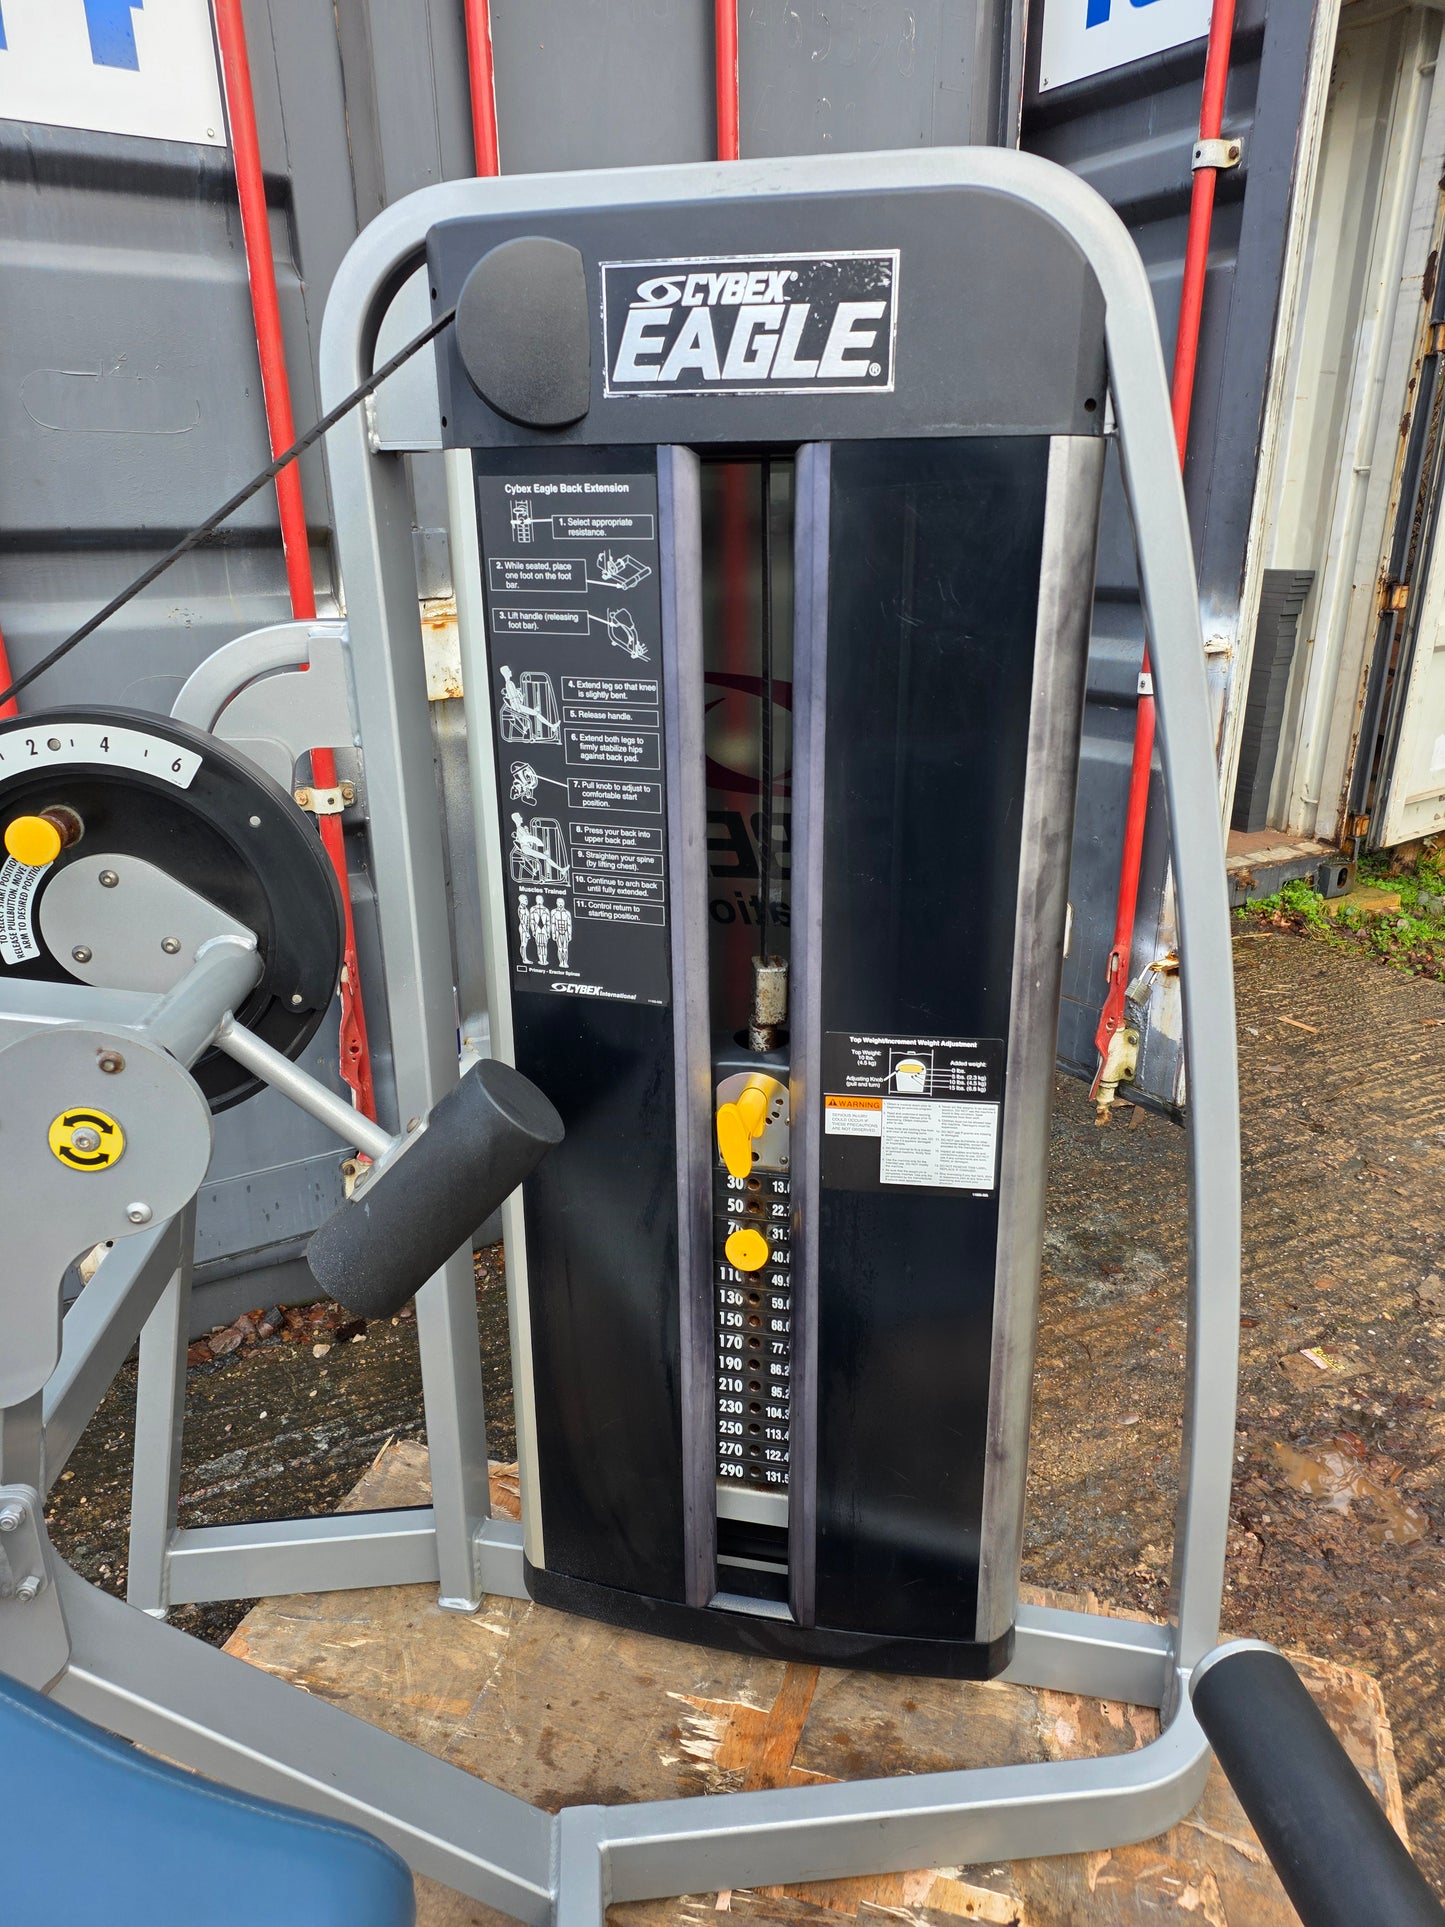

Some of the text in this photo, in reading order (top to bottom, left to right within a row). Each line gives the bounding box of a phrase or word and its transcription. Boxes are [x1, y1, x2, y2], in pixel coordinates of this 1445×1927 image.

[505, 482, 629, 495] Cybex Eagle Back Extension
[567, 517, 590, 526] Select
[591, 517, 633, 528] appropriate
[568, 528, 606, 536] resistance.
[504, 561, 524, 571] While
[525, 562, 551, 570] seated,
[552, 562, 572, 572] place
[519, 571, 533, 579] foot
[557, 571, 572, 580] foot
[506, 580, 520, 590] bar.
[507, 611, 518, 621] Lift
[519, 612, 543, 622] handle
[544, 612, 579, 622] (releasing
[508, 620, 539, 630] foot bar).
[576, 680, 601, 689] Extend
[623, 682, 638, 690] that
[638, 683, 656, 691] knee
[585, 690, 609, 700] slightly
[610, 690, 628, 699] bent.
[578, 710, 606, 719] Release
[607, 711, 632, 720] handle.
[579, 733, 603, 742] Extend
[604, 735, 620, 743] both
[620, 736, 635, 745] legs
[25, 736, 182, 773] 2 4 6
[579, 742, 643, 755] firmly stabilize hips
[580, 751, 605, 761] against
[623, 753, 639, 763] pad.
[581, 780, 594, 788] Pull
[595, 782, 612, 790] knob
[621, 782, 643, 792] adjust
[582, 790, 637, 800] comfortable start
[582, 799, 611, 808] position.
[584, 826, 603, 834] Press
[604, 828, 619, 837] your
[620, 827, 637, 836] back
[637, 828, 651, 838] into
[584, 835, 637, 846] upper back pad.
[585, 850, 619, 861] Straighten
[620, 853, 636, 862] your
[636, 854, 655, 864] spine
[597, 859, 616, 870] lifting
[615, 861, 640, 871] chest).
[0, 857, 17, 887] POSITIO
[586, 876, 616, 886] Continue
[625, 879, 640, 887] arch
[640, 881, 657, 889] back
[587, 885, 649, 897] until fully extended.
[18, 865, 42, 949] ARM TO DESIRED POSITIO
[587, 901, 612, 910] Control
[7, 866, 27, 959] RELEASE PULLBUTTON. MOVE
[588, 910, 641, 922] starting position.
[566, 983, 637, 1001] CYBEX International
[917, 1039, 940, 1047] Weight
[940, 1040, 977, 1048] Adjustment
[838, 1100, 880, 1109] WARNING
[727, 1175, 744, 1190] 30
[727, 1198, 744, 1213] 50
[720, 1290, 743, 1305] 130
[719, 1312, 743, 1327] 150
[719, 1334, 743, 1350] 170
[719, 1356, 790, 1376] 190 86.2
[718, 1377, 743, 1392] 210
[719, 1399, 790, 1420] 230 104.3
[719, 1420, 790, 1441] 250 113.4
[719, 1442, 790, 1462] 270 122.4
[720, 1463, 790, 1484] 290 131.5
